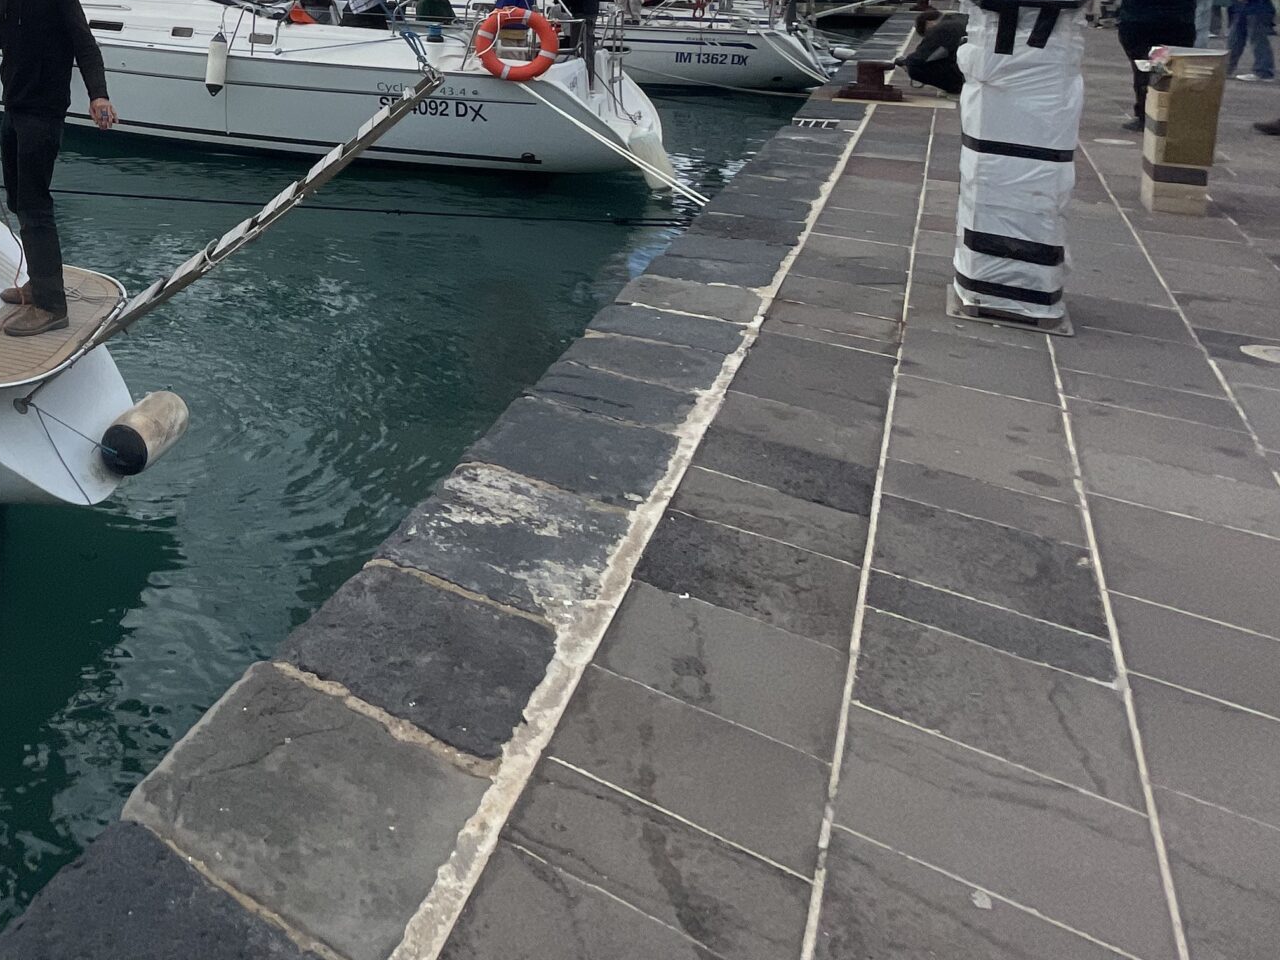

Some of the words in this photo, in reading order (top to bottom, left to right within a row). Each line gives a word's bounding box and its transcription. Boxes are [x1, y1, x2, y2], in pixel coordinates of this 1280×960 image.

[675, 52, 691, 64] IM
[695, 53, 728, 65] 1362
[731, 54, 749, 66] DX
[455, 102, 487, 122] DX
